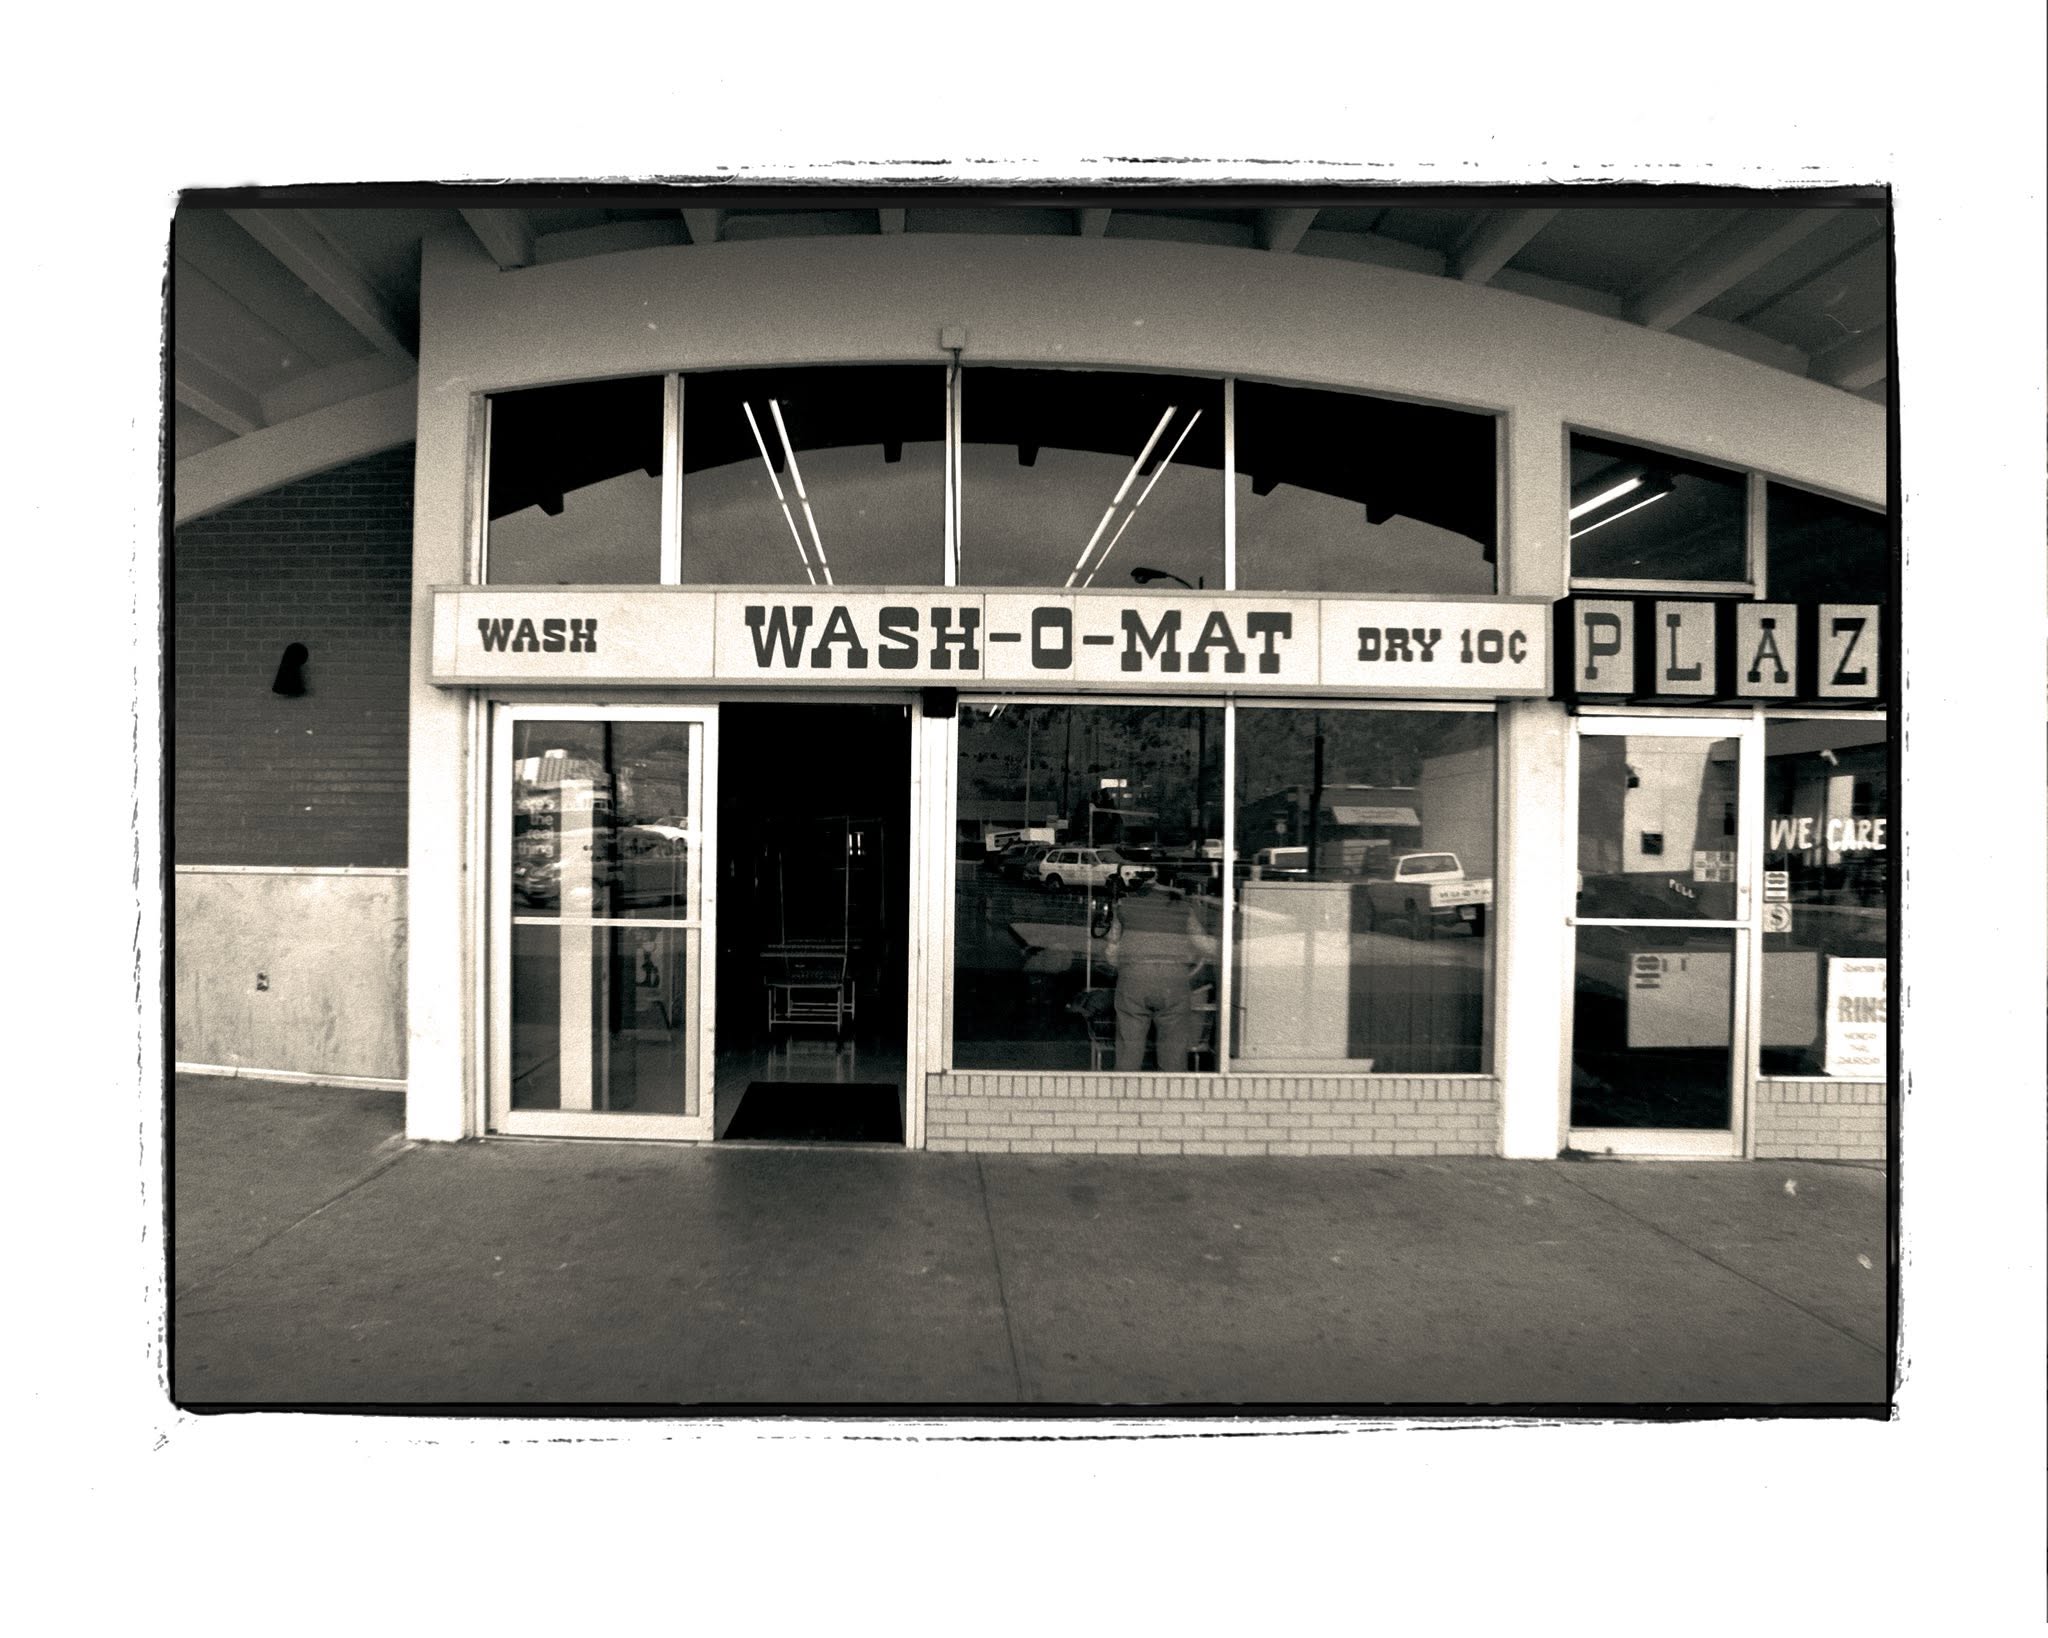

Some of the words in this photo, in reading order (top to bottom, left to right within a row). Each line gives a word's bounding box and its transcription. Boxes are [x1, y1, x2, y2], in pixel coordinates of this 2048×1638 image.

[477, 618, 598, 653] WASH
[744, 605, 1293, 674] WASH-O-MAT
[1357, 627, 1442, 662] DRY
[1460, 628, 1528, 664] 10¢
[1584, 611, 1868, 685] PLAZ
[1770, 817, 1813, 850] WE
[1826, 818, 1887, 851] CARE
